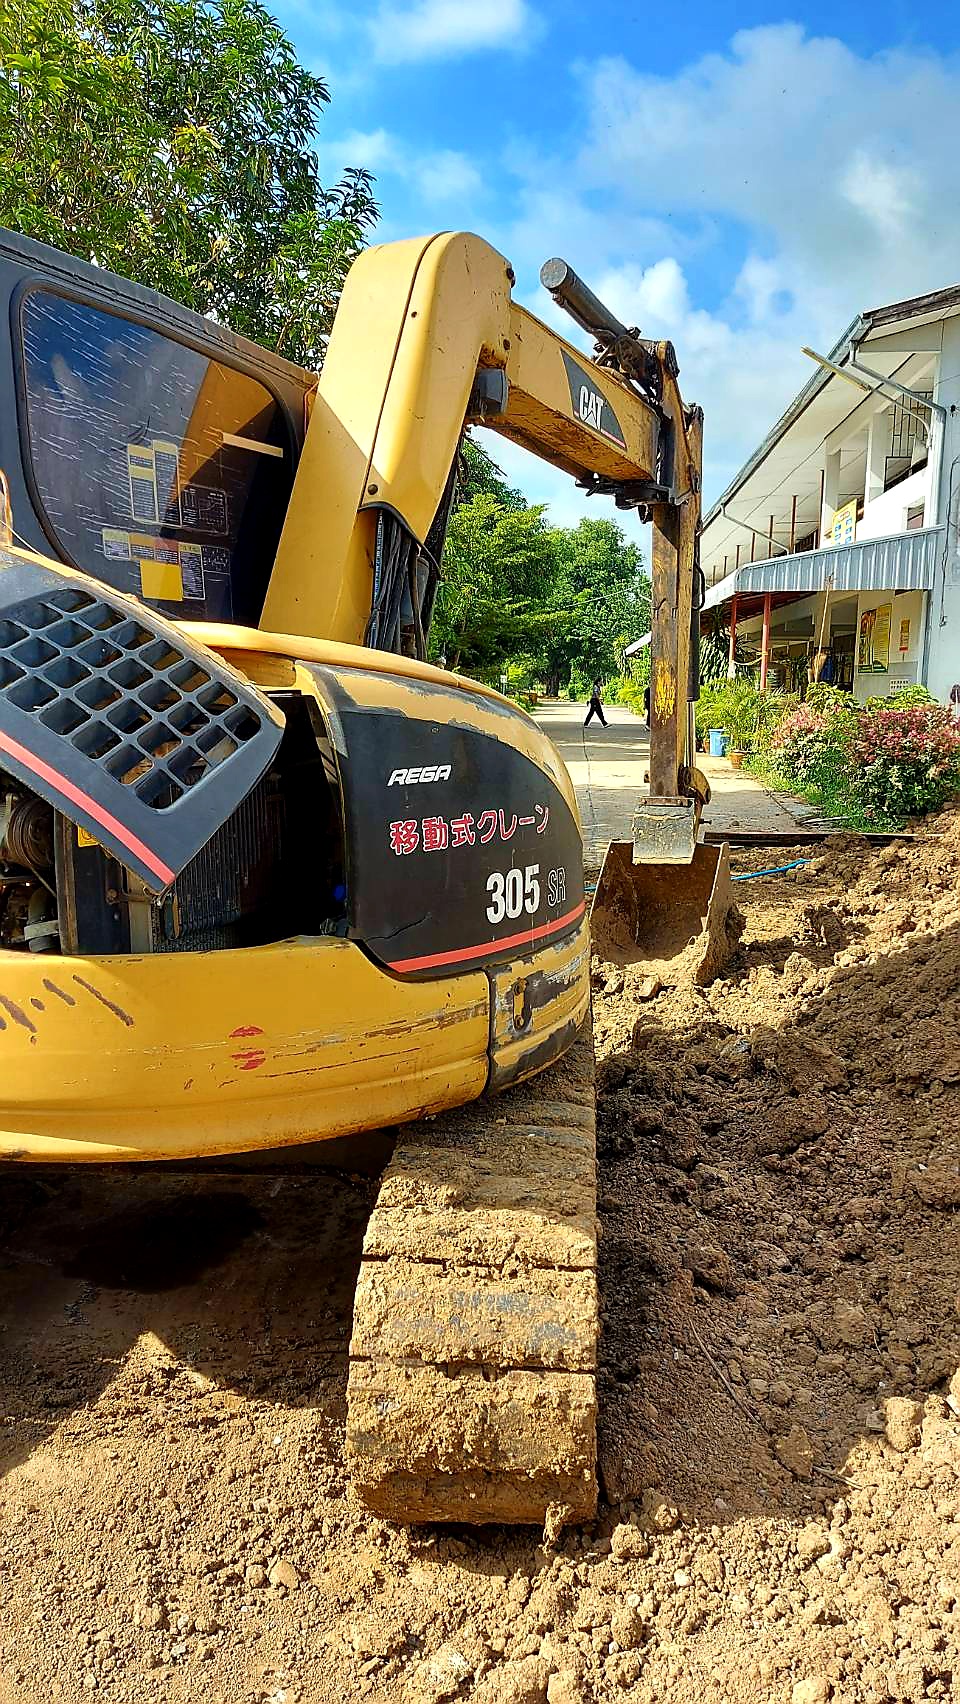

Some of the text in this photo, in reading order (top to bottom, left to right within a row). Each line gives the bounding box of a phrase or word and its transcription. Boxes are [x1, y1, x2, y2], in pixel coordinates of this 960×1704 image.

[580, 385, 604, 430] CAT
[390, 805, 549, 854] 移動式クレーン
[486, 864, 566, 923] 305 SR
